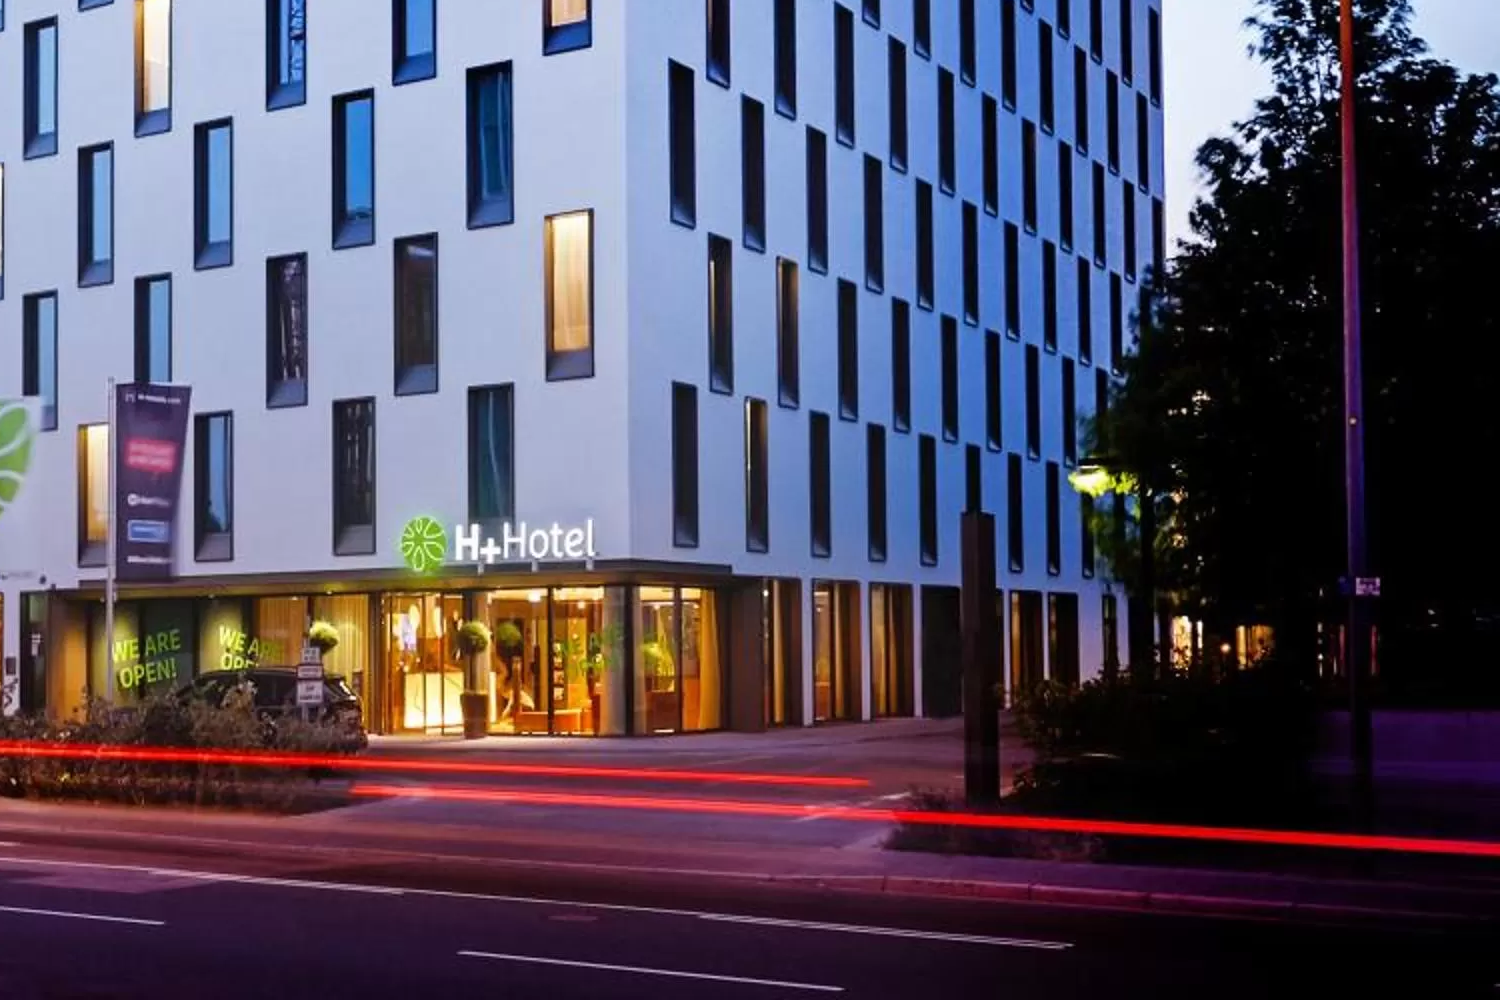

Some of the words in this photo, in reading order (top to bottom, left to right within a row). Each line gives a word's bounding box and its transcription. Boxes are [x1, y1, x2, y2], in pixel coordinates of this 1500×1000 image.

[455, 518, 595, 564] H+Hotel
[112, 638, 140, 664] WE
[145, 628, 181, 656] ARE
[220, 625, 247, 653] WE
[120, 657, 177, 688] OPEN!
